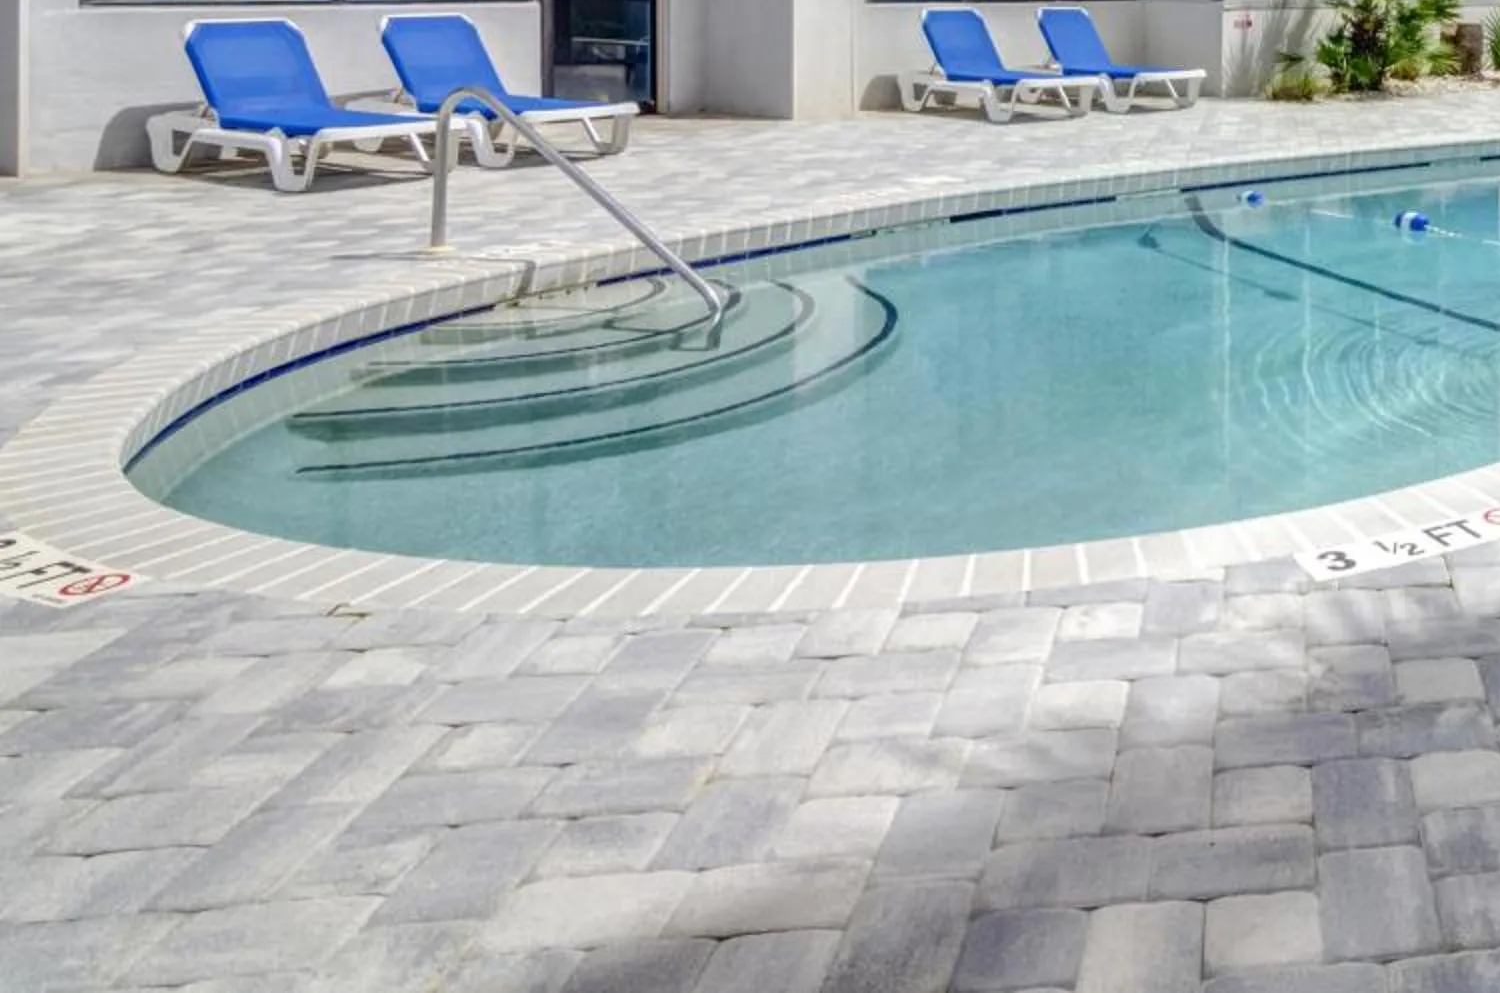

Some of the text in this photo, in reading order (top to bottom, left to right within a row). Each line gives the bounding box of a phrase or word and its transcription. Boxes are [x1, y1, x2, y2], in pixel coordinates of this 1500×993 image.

[1316, 550, 1357, 572] 3
[1422, 518, 1483, 548] FT
[0, 560, 92, 589] FT
